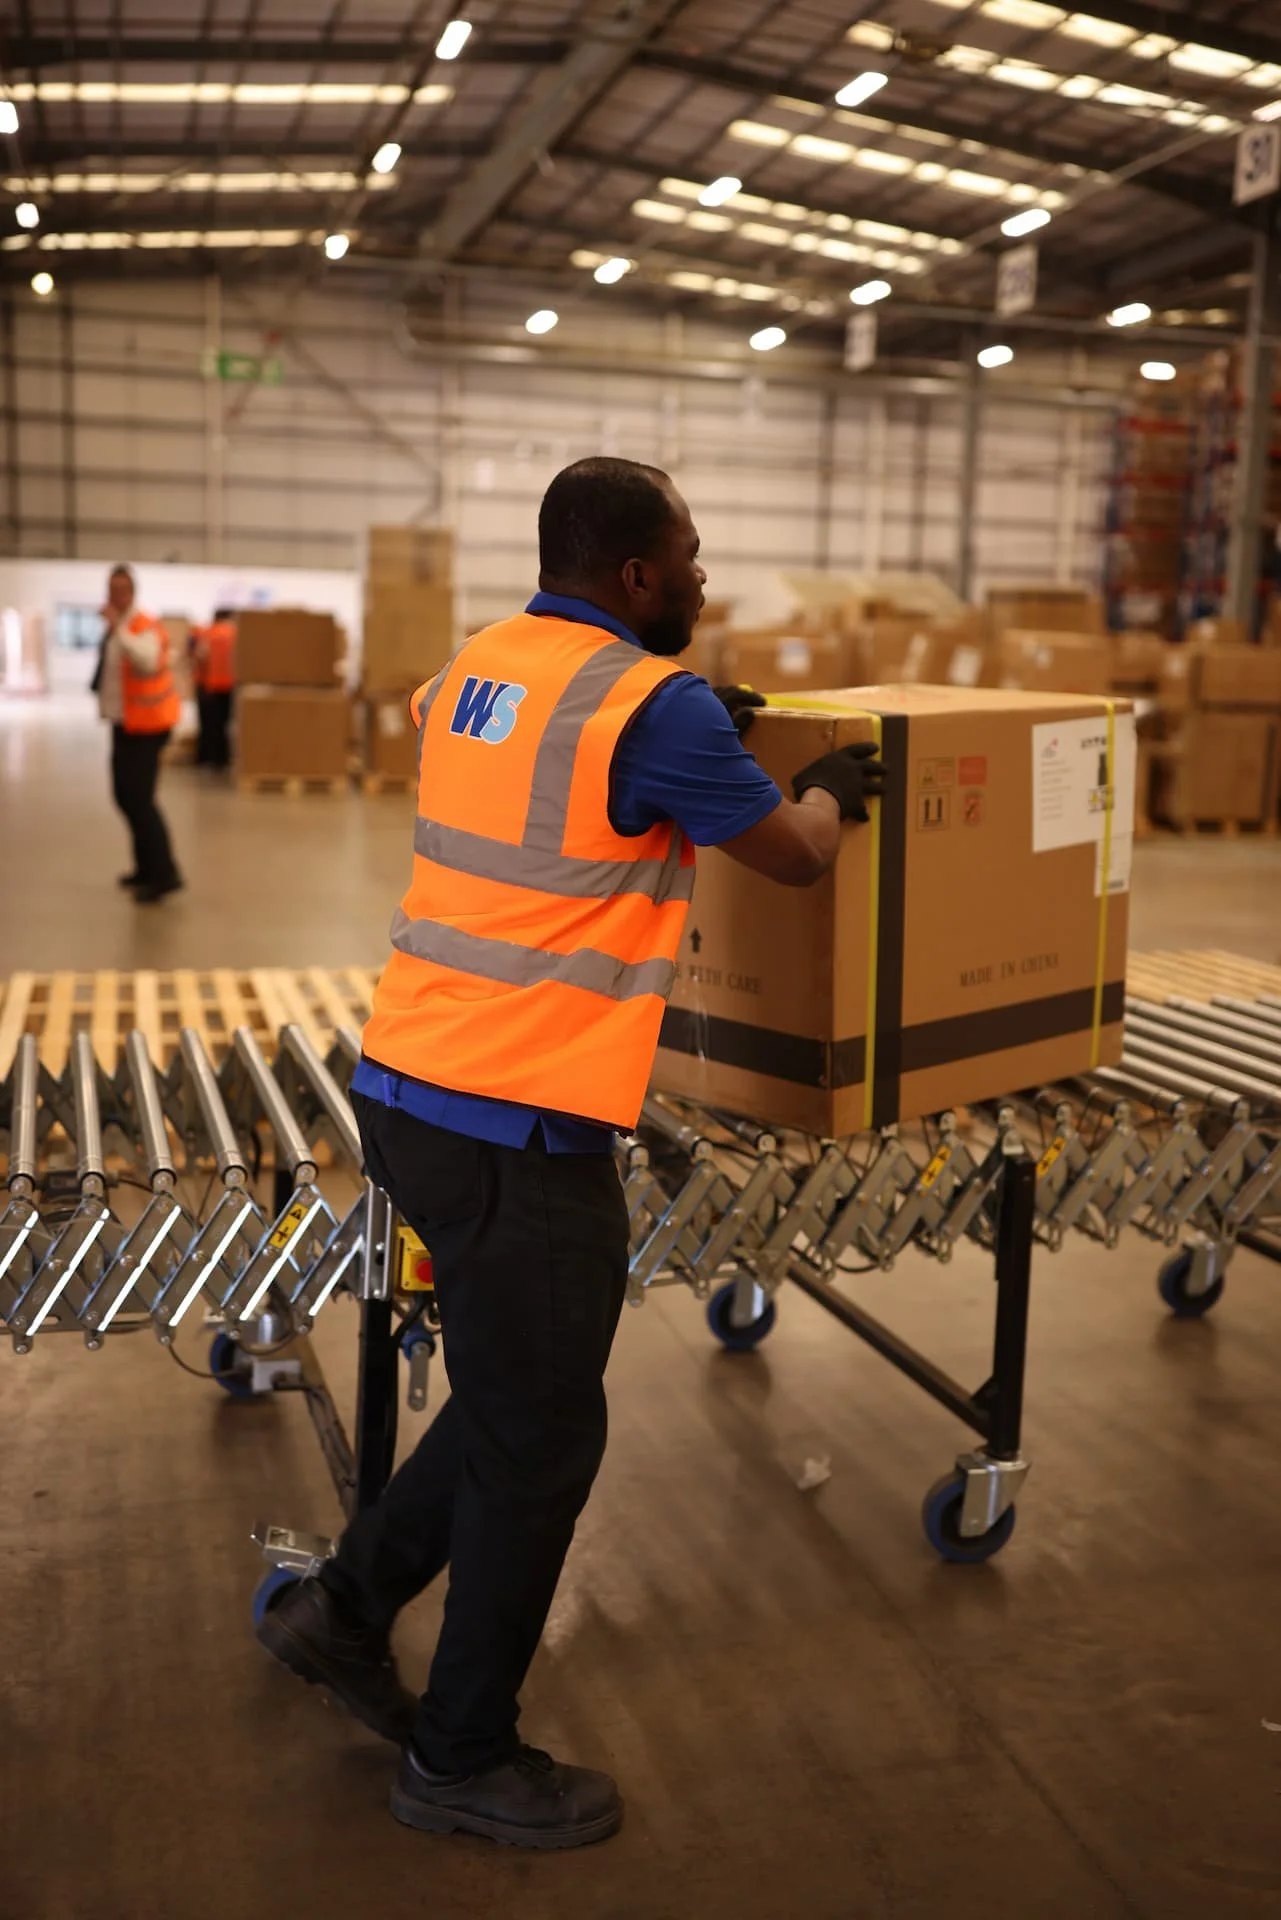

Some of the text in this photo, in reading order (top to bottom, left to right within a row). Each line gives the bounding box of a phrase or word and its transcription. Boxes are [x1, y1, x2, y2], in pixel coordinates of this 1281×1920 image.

[449, 675, 528, 745] WS
[688, 964, 722, 987] WITH
[727, 972, 763, 995] CARE
[959, 952, 1059, 988] MADE IN CHINA
